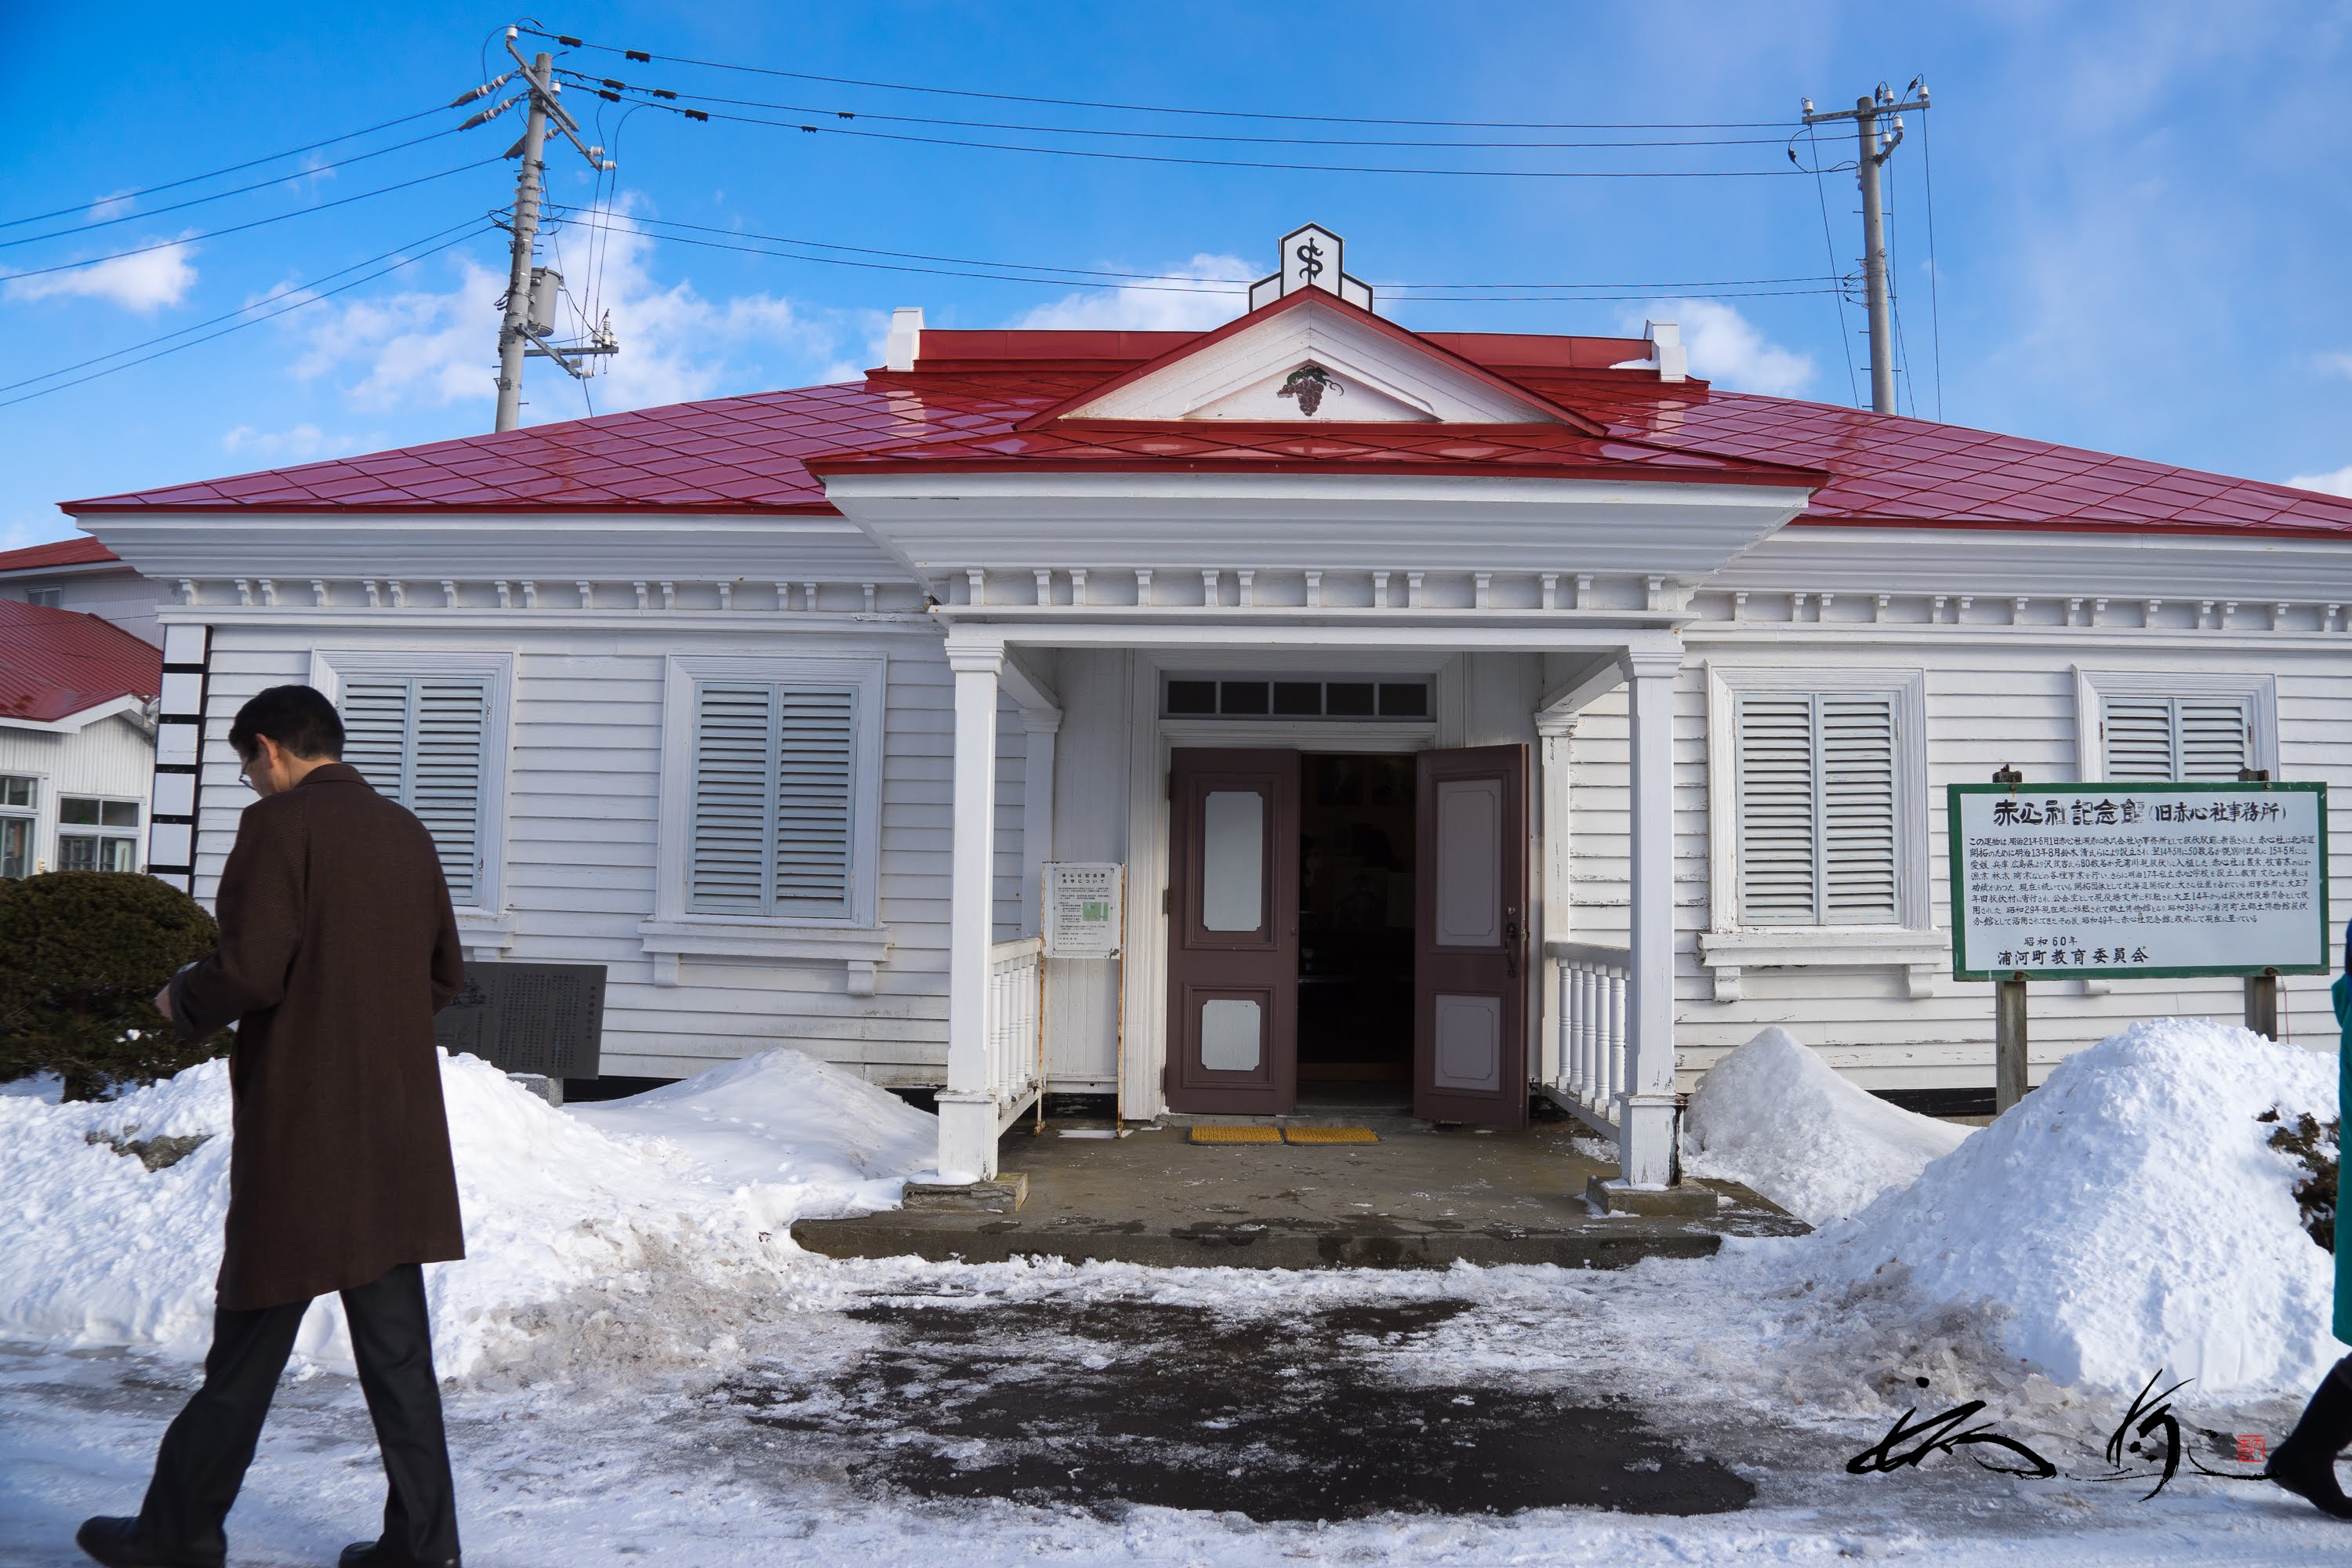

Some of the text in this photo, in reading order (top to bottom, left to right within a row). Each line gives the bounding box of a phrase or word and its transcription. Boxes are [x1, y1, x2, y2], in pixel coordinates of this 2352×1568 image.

[1998, 947, 2150, 966] 浦河町教育委員会
